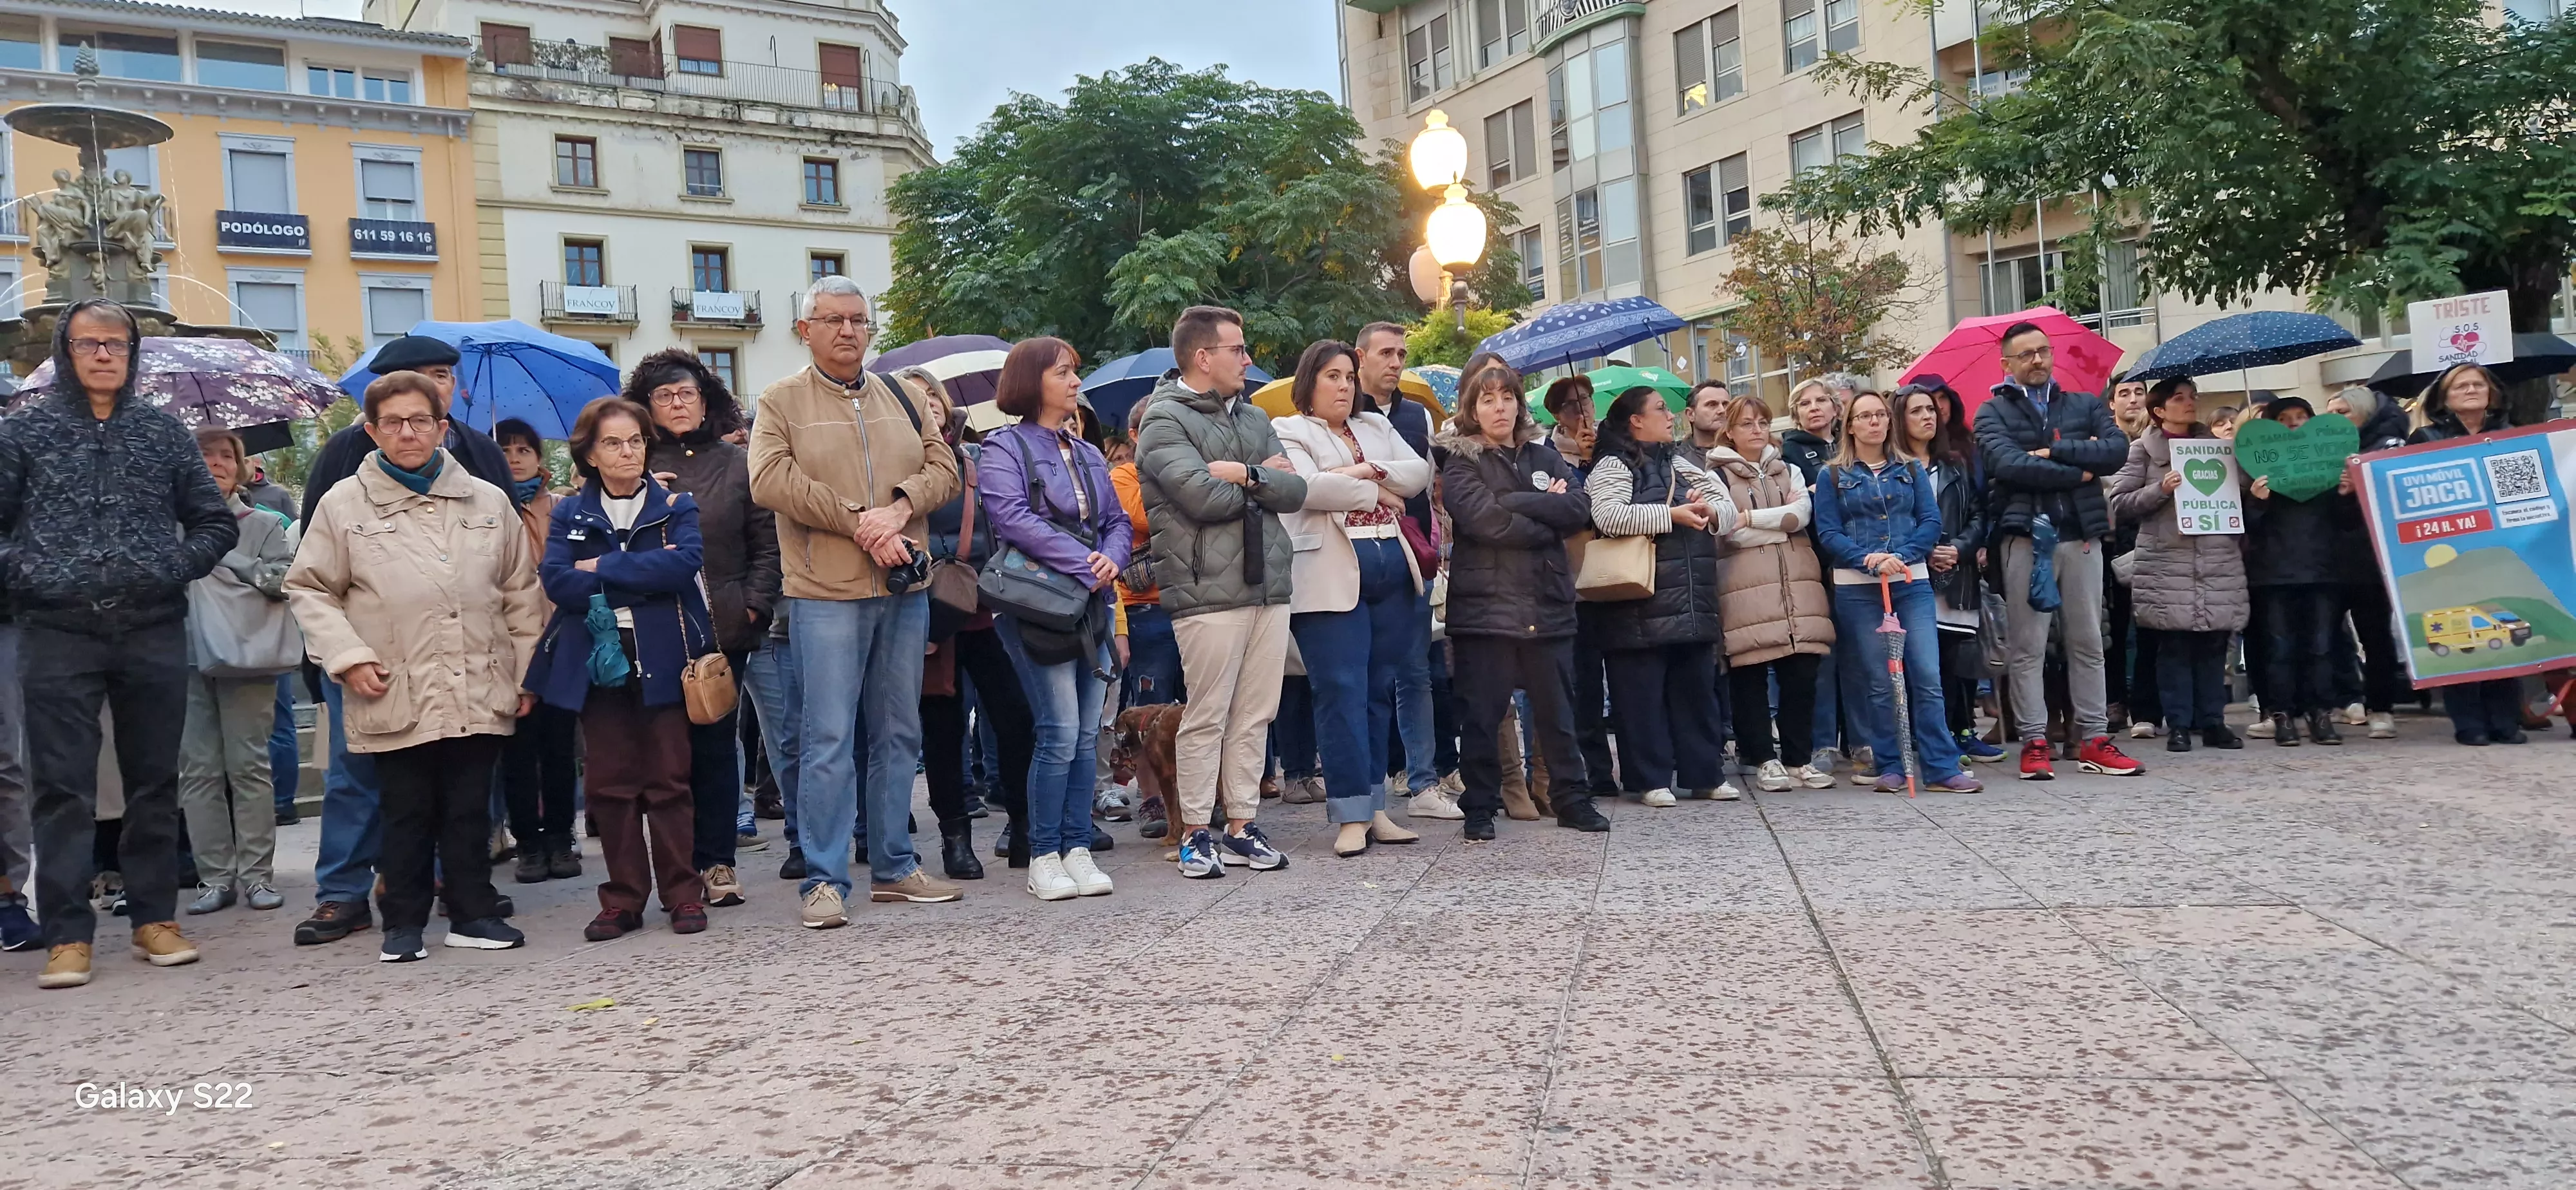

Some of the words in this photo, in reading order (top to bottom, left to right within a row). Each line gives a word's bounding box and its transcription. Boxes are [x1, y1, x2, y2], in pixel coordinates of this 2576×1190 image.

[221, 222, 305, 236] PODÓLOGO
[354, 229, 376, 241] 611
[381, 230, 395, 241] 59
[399, 231, 414, 243] 16
[417, 232, 431, 243] 16
[2432, 297, 2490, 319] TRISTE
[2438, 350, 2478, 363] SANIDAD
[2235, 437, 2253, 448] LA
[2176, 446, 2232, 455] SANIDAD
[2254, 449, 2279, 464] NO
[2287, 444, 2309, 461] SE
[2192, 469, 2218, 480] GRACIAS
[2426, 469, 2465, 482] MÓVIL
[2406, 480, 2472, 507] JACA
[2183, 498, 2238, 509] PÚBLICA
[2198, 511, 2221, 531] SÍ
[2423, 521, 2439, 535] 24
[2441, 521, 2455, 532] H.
[2456, 515, 2477, 530] YA!
